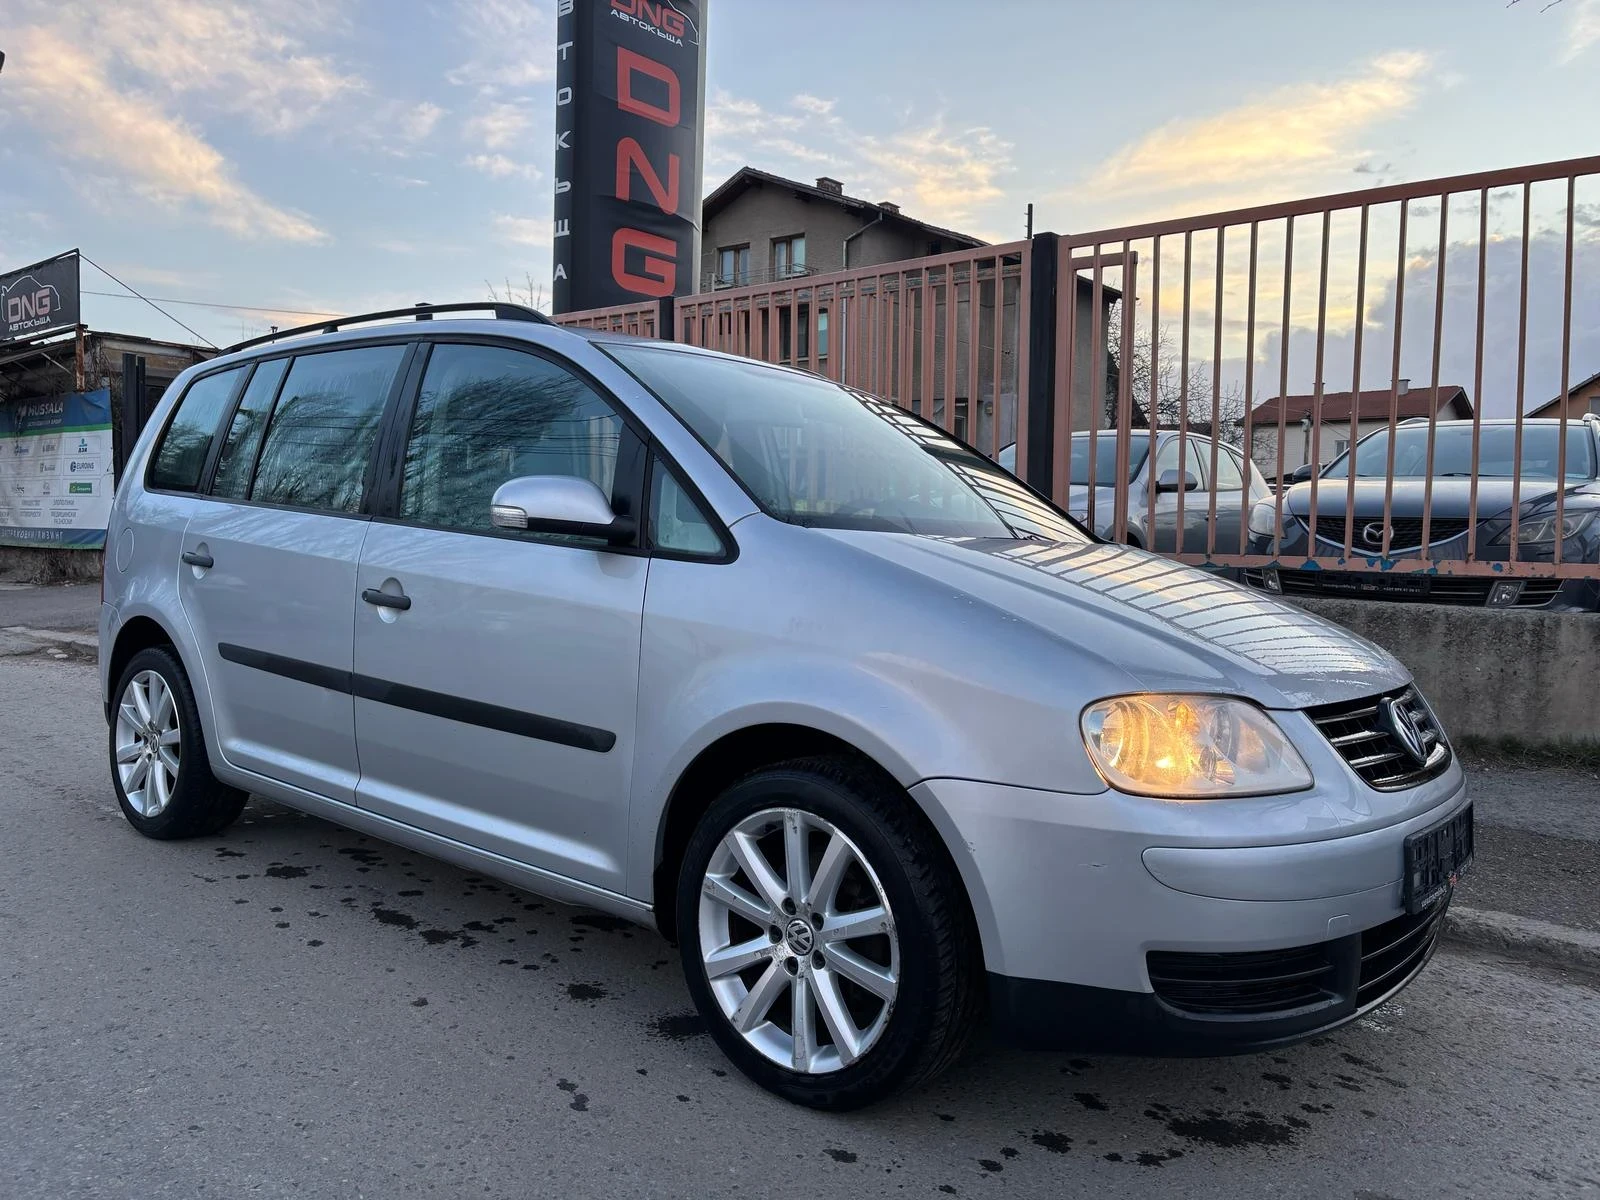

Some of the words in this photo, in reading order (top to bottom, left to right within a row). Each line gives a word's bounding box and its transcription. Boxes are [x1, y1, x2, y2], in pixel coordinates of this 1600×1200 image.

[612, 46, 682, 297] DNG
[7, 288, 51, 324] DNG
[28, 402, 63, 416] MUSSALA
[76, 462, 94, 470] EUROINS
